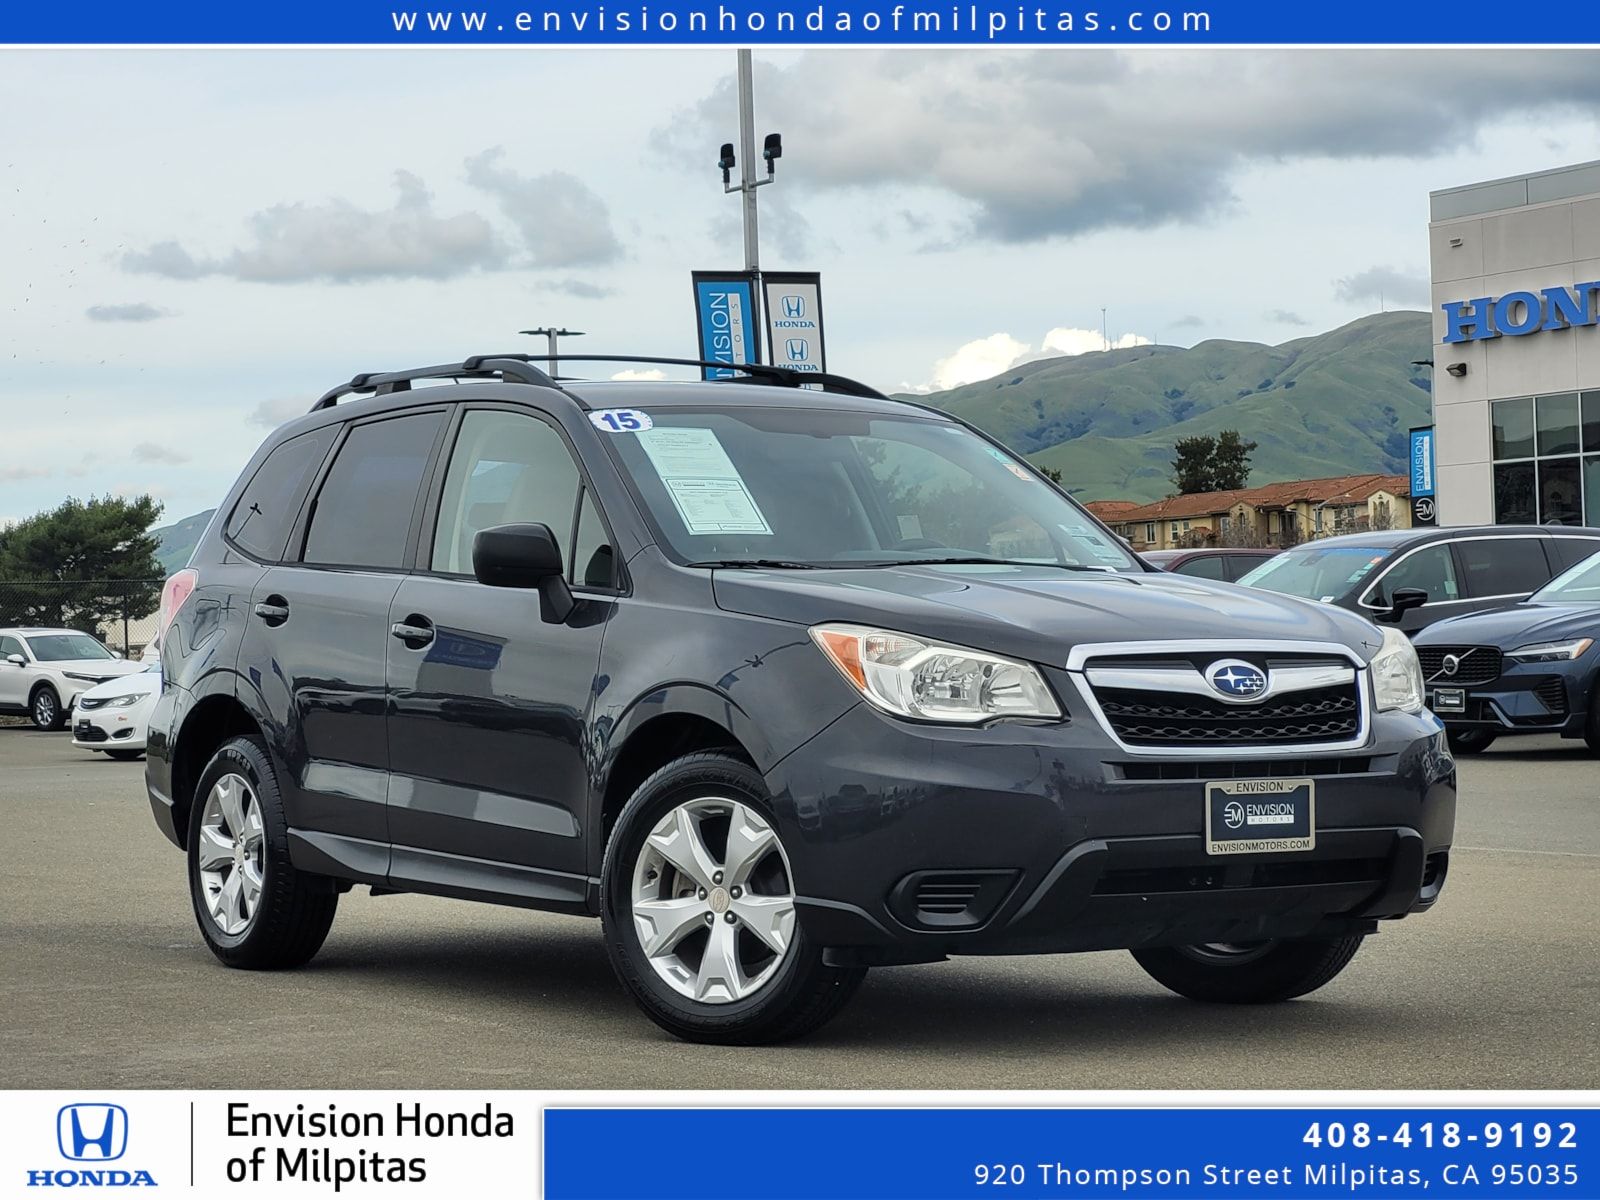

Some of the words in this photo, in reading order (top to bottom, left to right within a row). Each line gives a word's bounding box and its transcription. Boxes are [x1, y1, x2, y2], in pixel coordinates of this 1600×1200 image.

[1442, 281, 1600, 343] HON
[774, 320, 816, 328] HONDA
[602, 412, 641, 430] 15
[1415, 436, 1425, 492] ENVISION
[1236, 782, 1284, 792] ENVISION
[1246, 803, 1295, 815] ENVISION
[1211, 840, 1310, 853] ENVISIONMOTORS.COM
